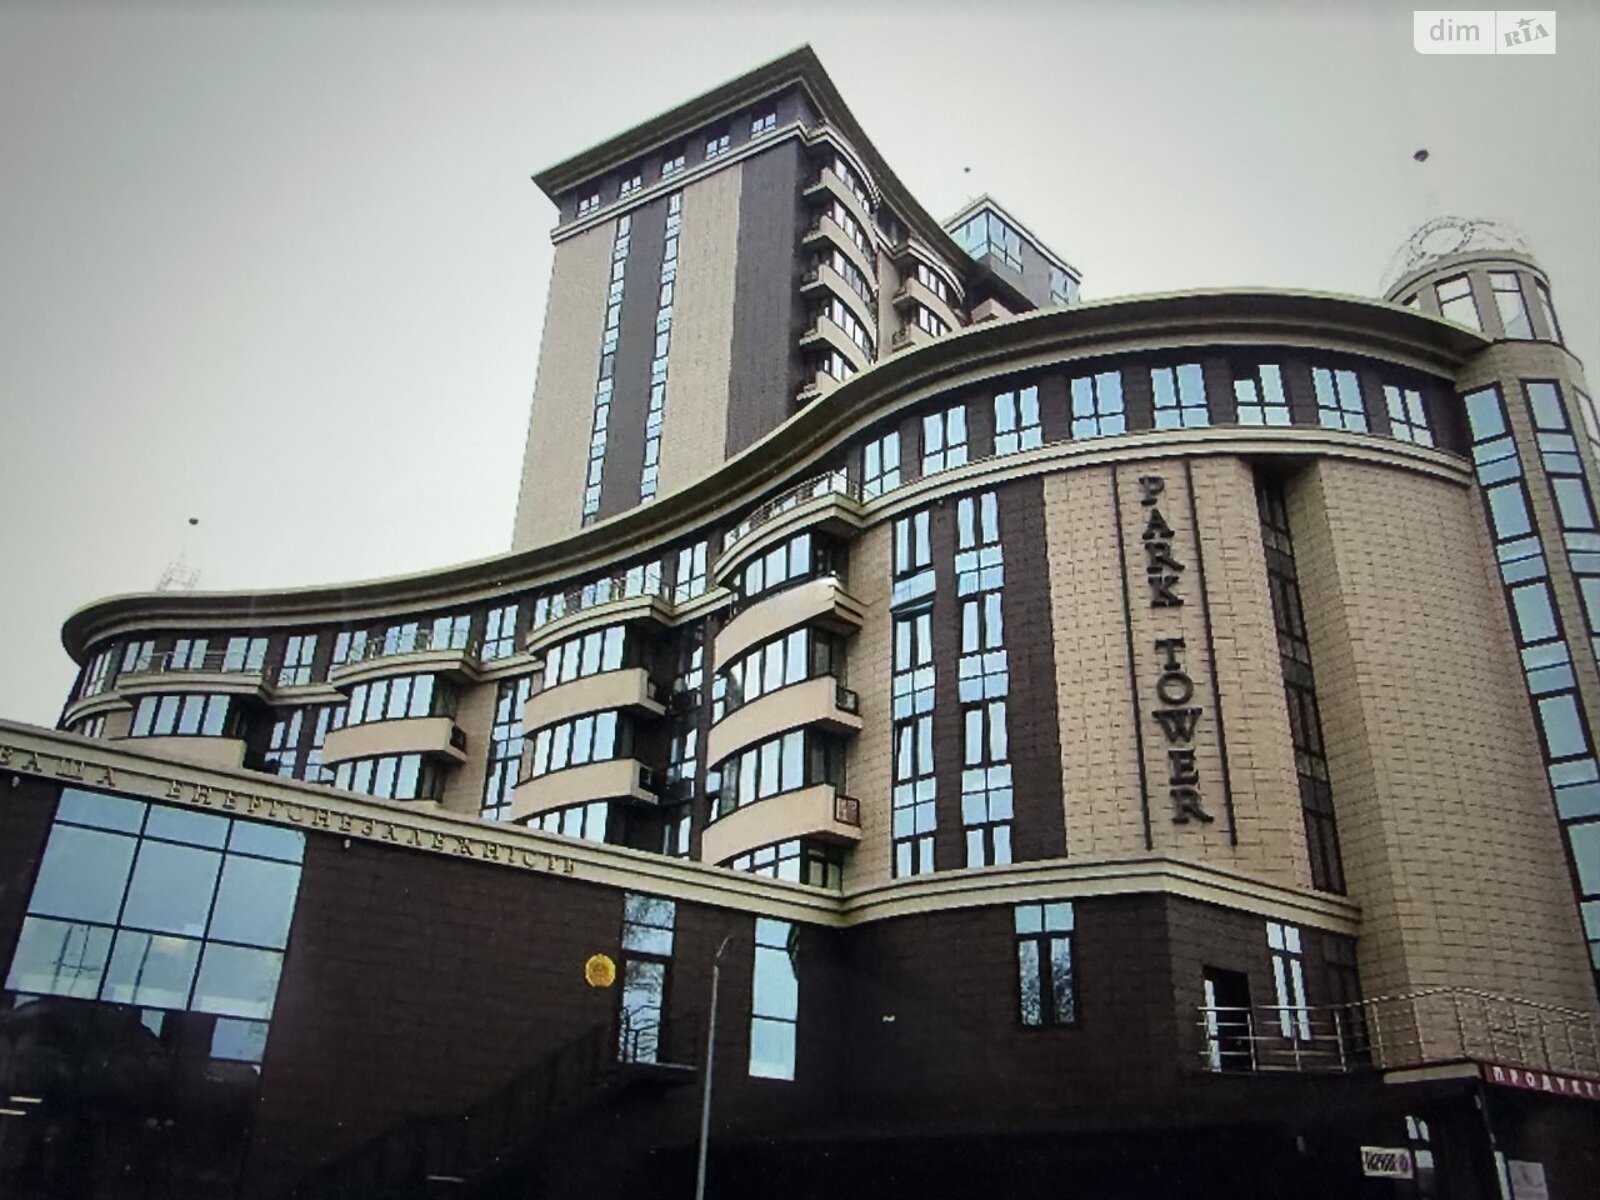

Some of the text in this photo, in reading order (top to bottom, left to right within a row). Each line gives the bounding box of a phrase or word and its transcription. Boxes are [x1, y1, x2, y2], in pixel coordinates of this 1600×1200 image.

[1139, 476, 1214, 824] PARK TOWER
[1492, 1066, 1600, 1097] ПРОДУКТ
